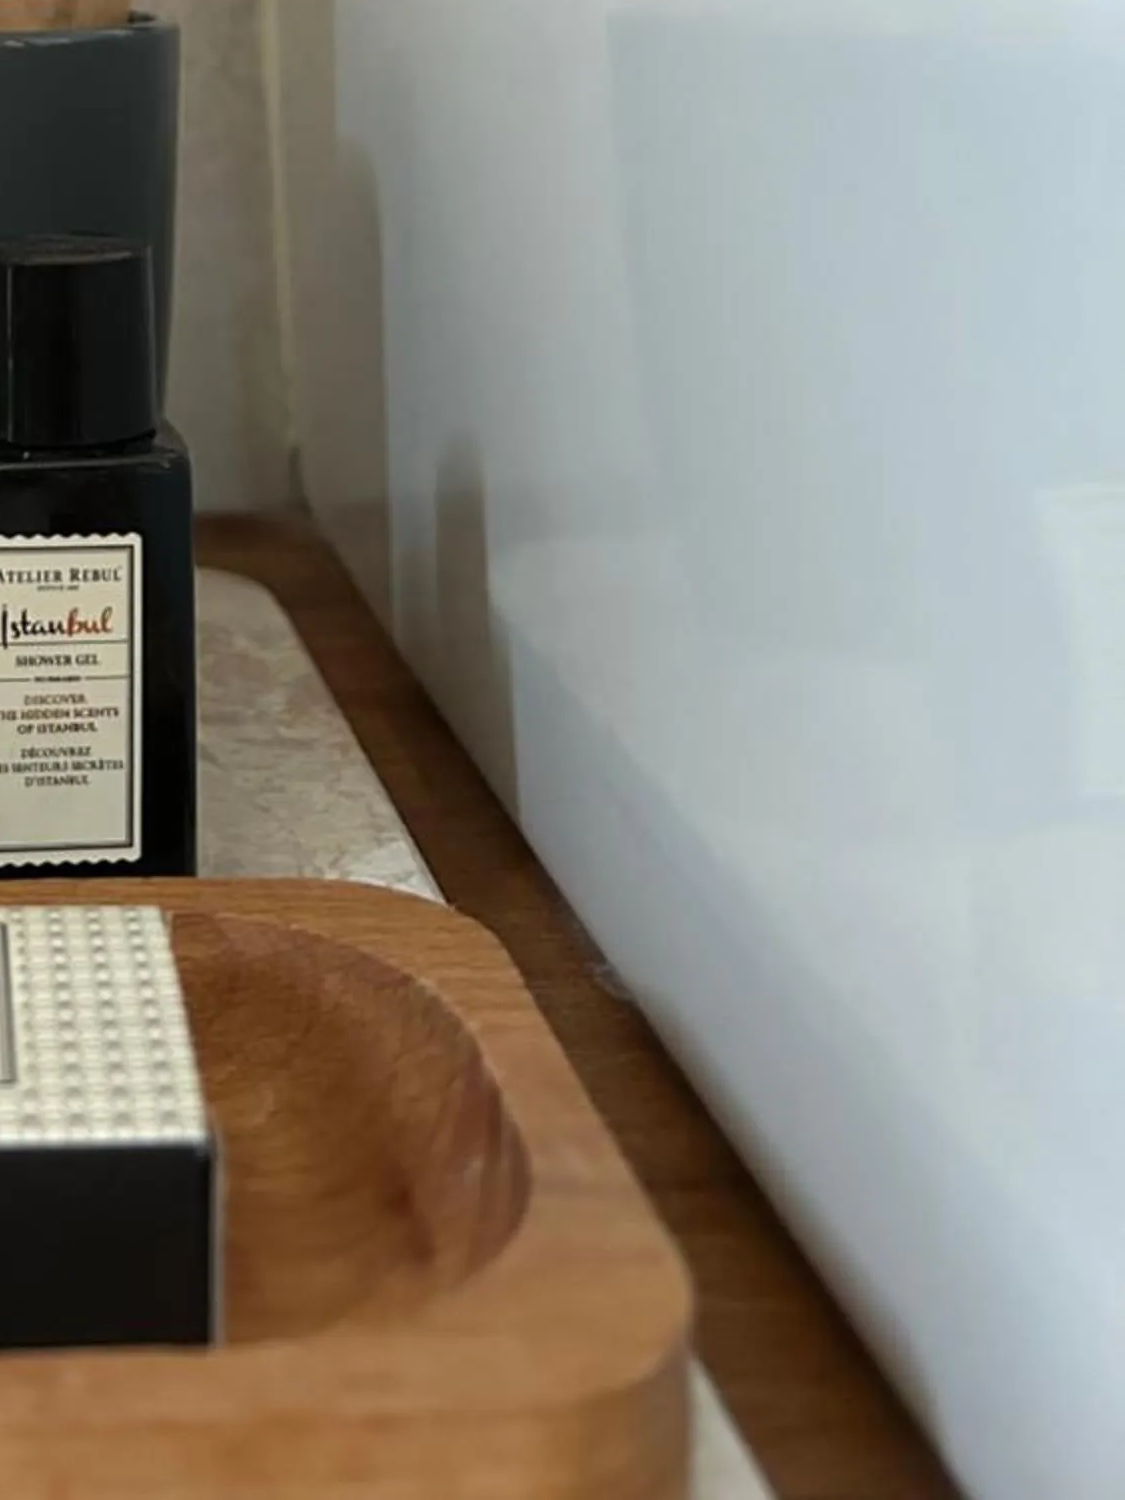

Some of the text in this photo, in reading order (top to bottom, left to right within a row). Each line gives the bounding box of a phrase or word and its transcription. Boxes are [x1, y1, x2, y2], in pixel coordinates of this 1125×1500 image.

[69, 566, 122, 582] REBUL
[15, 654, 99, 667] SHOWER GEL
[23, 694, 87, 706] DISCOVER
[20, 709, 69, 720] HIDDEN
[73, 708, 119, 719] SCENTS
[17, 723, 97, 735] OF ISTANBUL
